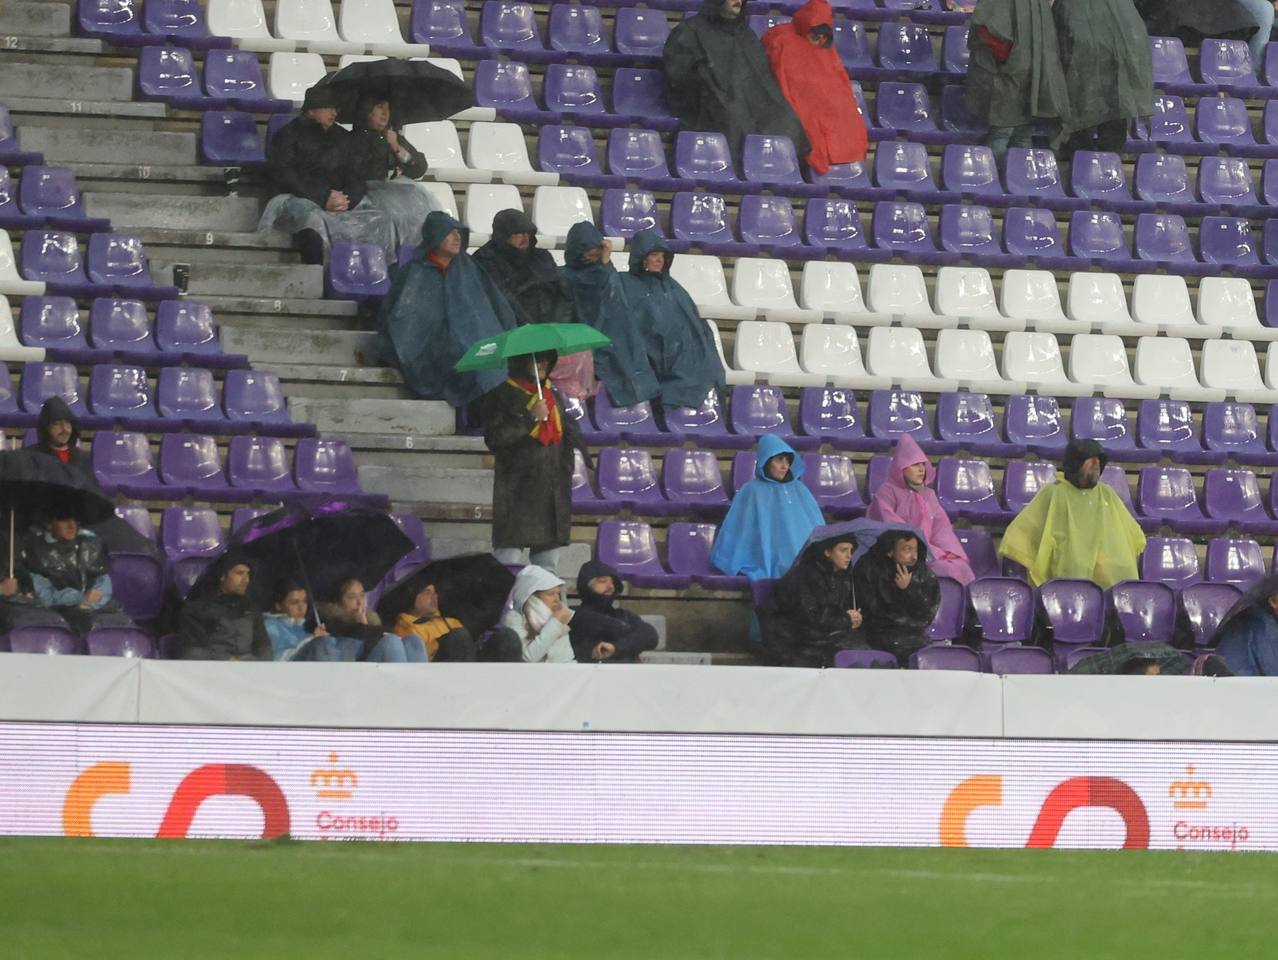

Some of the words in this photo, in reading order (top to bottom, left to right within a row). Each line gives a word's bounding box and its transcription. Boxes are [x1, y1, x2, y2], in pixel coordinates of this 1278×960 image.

[5, 36, 18, 48] 12
[71, 102, 82, 113] 11
[139, 166, 150, 178] 10
[206, 233, 213, 245] 9
[274, 300, 281, 312] 8
[341, 370, 348, 382] 7
[405, 436, 414, 449] 6
[473, 507, 483, 519] 5
[316, 810, 399, 836] Consejo
[1173, 820, 1248, 843] Consejo
